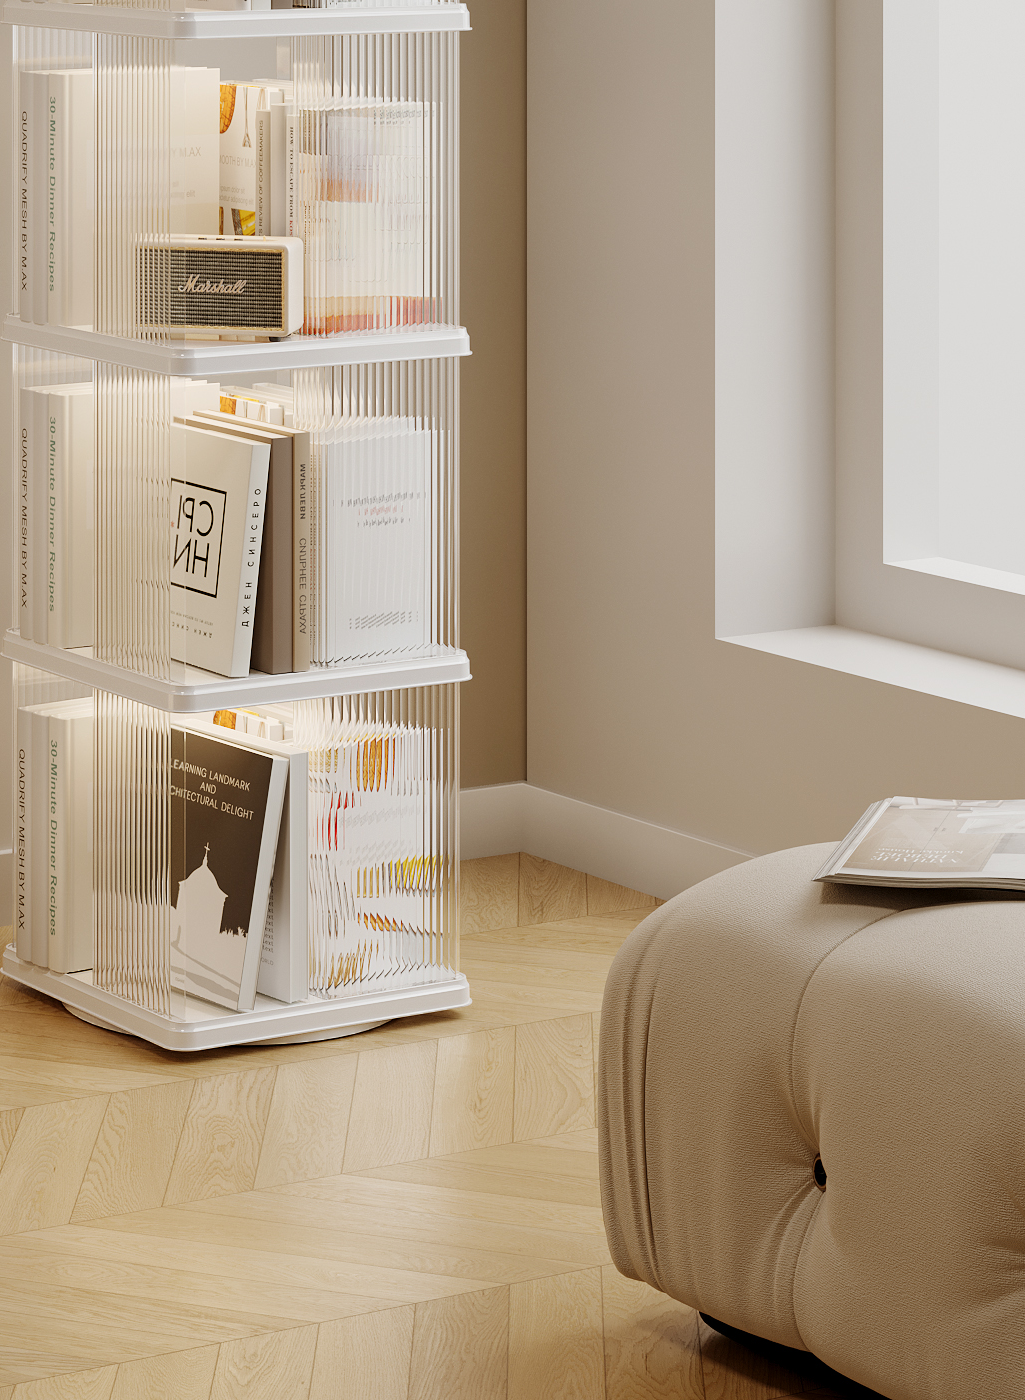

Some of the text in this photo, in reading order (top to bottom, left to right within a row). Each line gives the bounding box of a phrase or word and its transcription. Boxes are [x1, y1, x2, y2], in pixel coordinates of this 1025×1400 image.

[289, 149, 294, 160] TO
[259, 184, 263, 195] OF
[21, 234, 27, 252] BY
[178, 274, 247, 294] Marshall
[21, 551, 27, 569] BY
[241, 488, 261, 628] ДЖЕН СИНСЕРО
[200, 782, 217, 794] AND
[209, 770, 250, 792] LANDMARK
[170, 785, 254, 820] CHITECTURAL DELIGHT
[18, 871, 25, 891] BY
